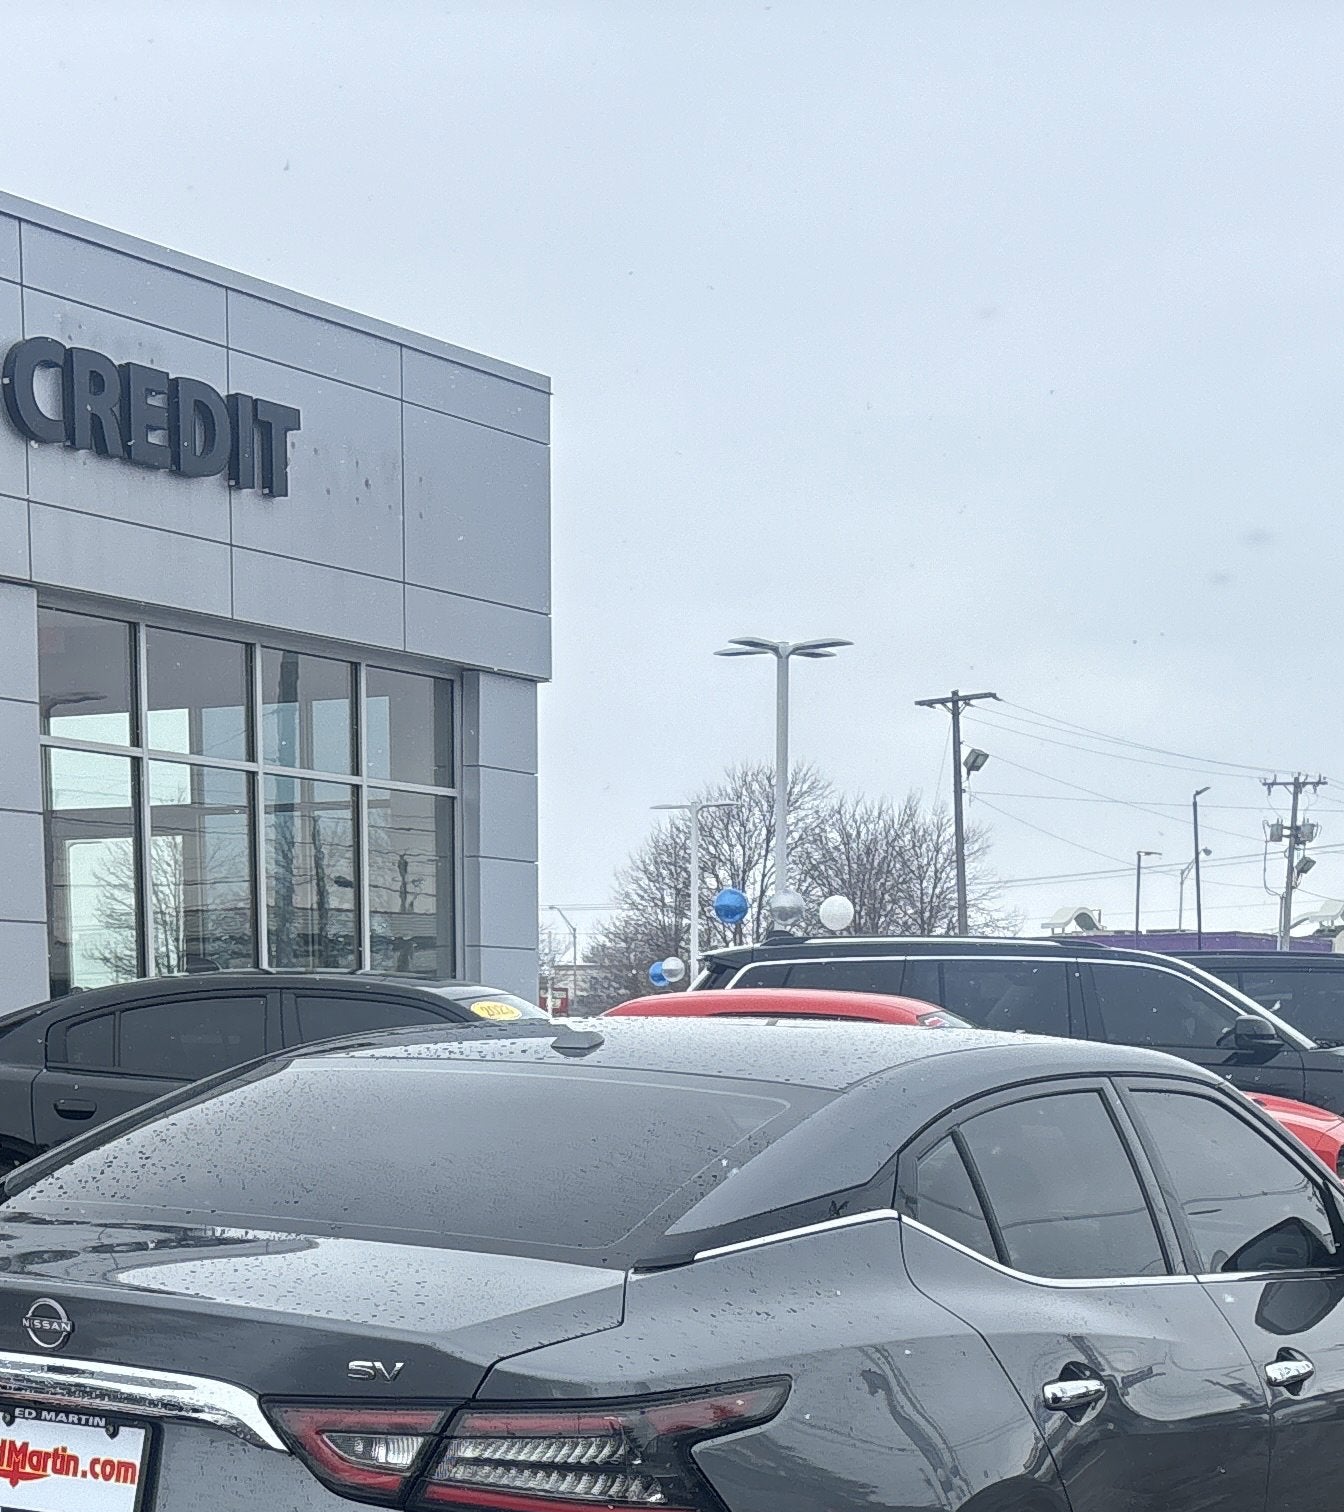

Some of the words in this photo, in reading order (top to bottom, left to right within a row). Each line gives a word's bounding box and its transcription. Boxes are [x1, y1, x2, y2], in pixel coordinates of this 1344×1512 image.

[3, 337, 301, 498] CREDIT
[22, 1317, 71, 1332] NISSAN
[347, 1360, 405, 1382] SV
[14, 1407, 37, 1419] ED
[40, 1410, 106, 1427] MARTIN
